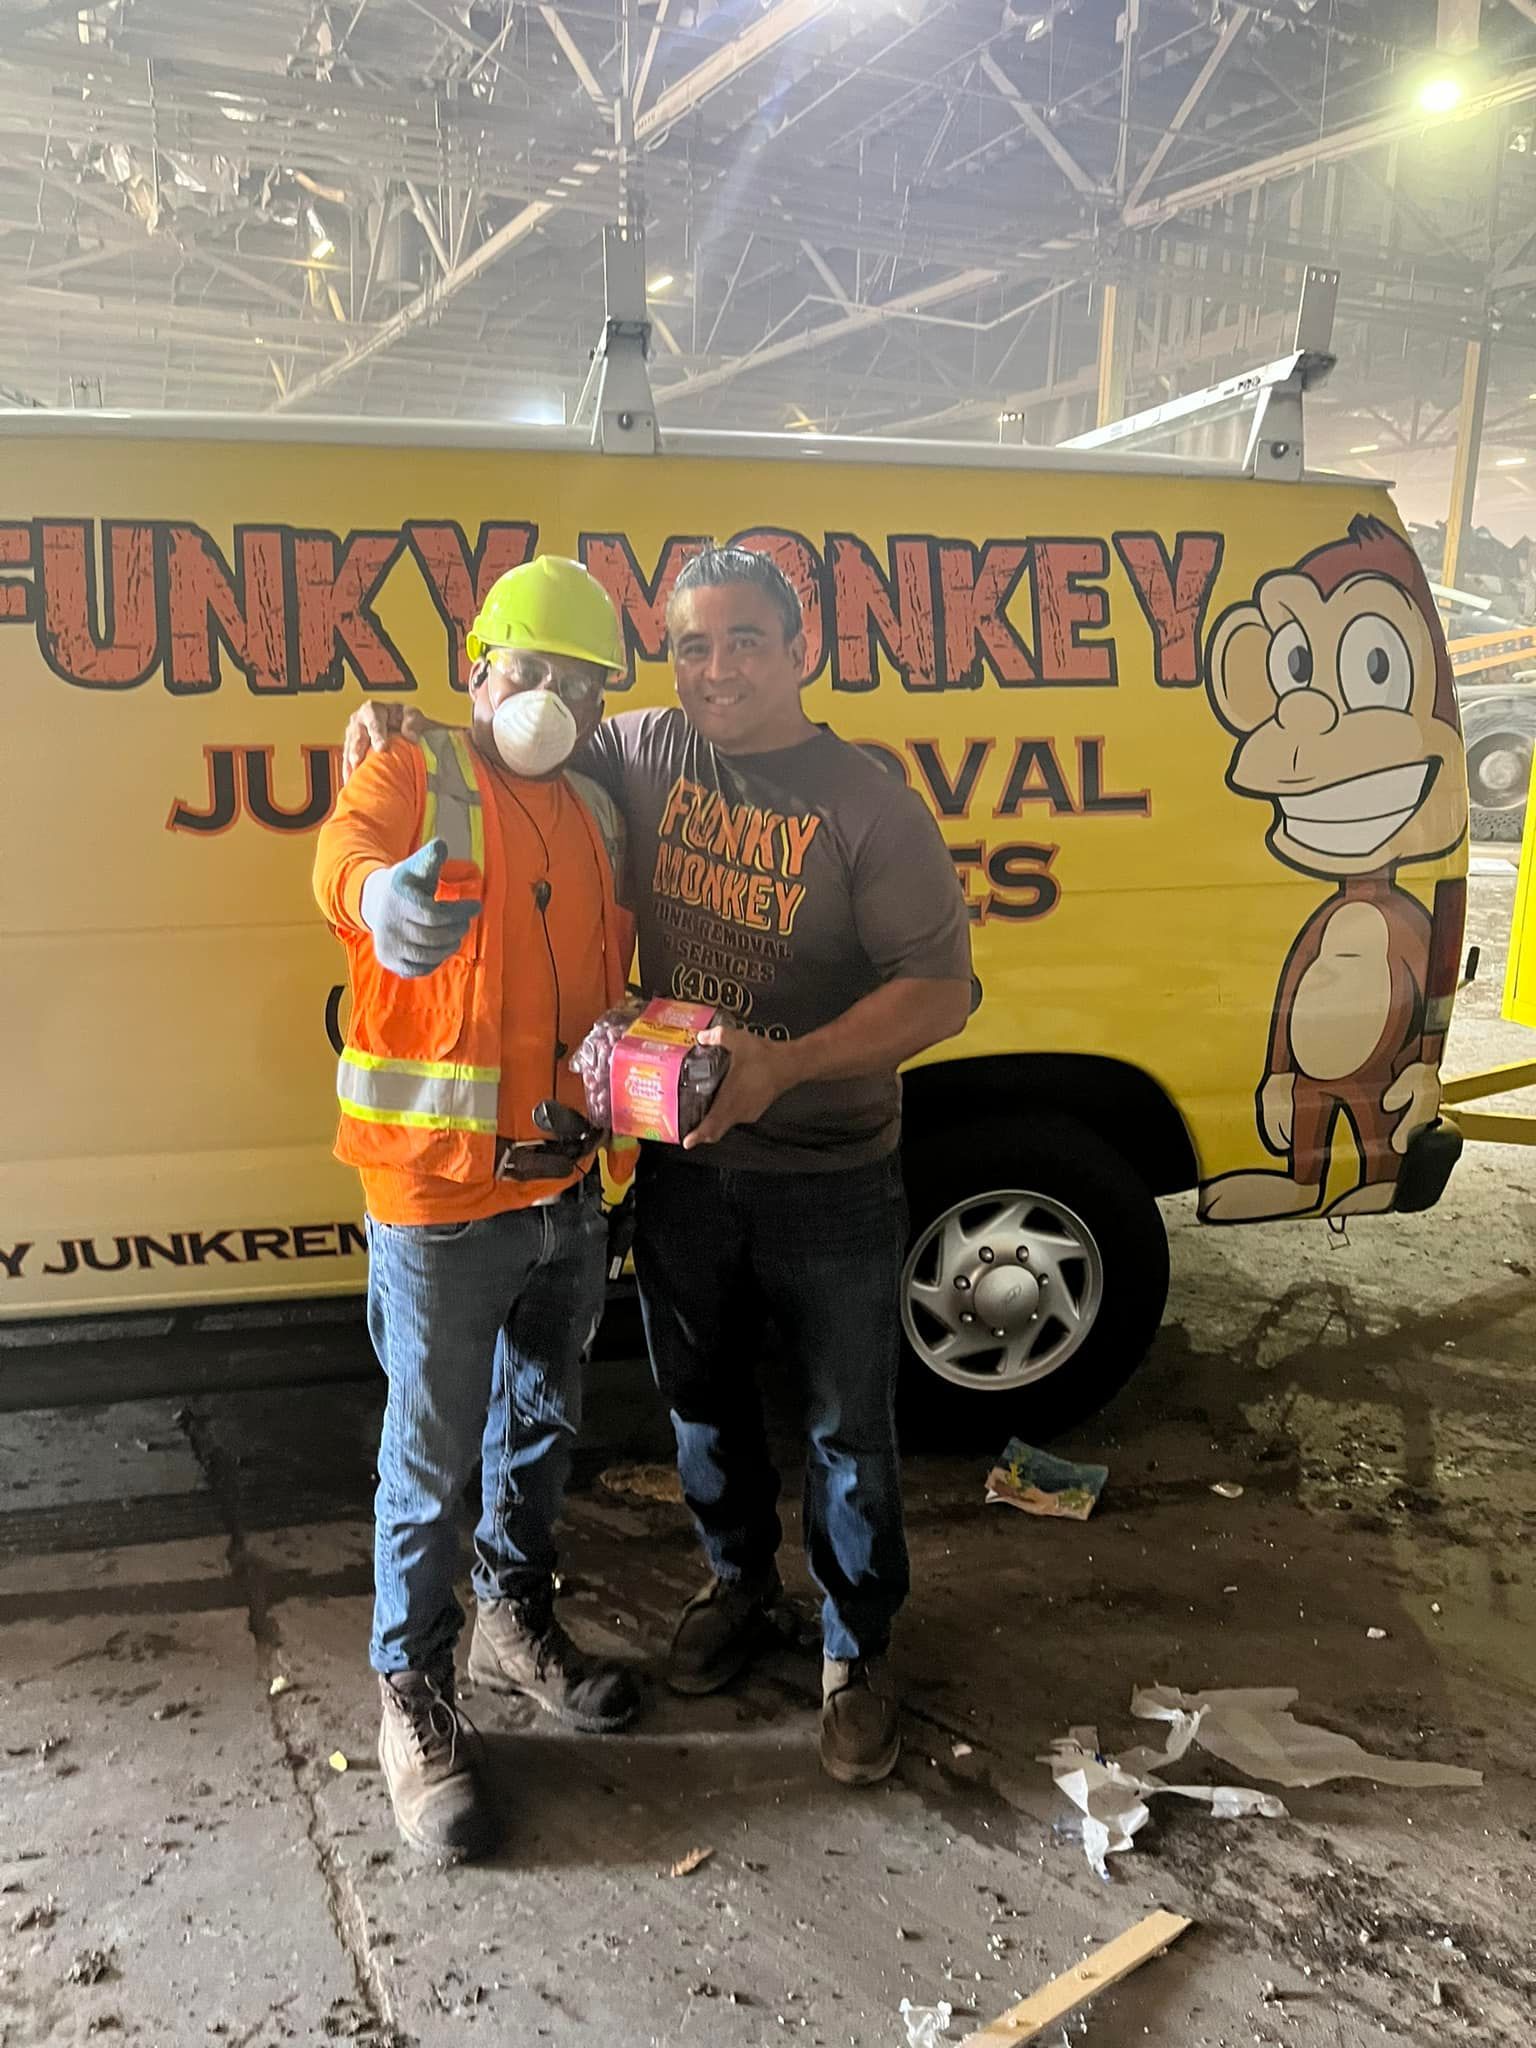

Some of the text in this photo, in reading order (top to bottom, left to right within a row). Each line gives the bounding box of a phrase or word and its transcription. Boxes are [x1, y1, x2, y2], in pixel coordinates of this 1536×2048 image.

[165, 744, 345, 836] JU
[659, 778, 821, 878] FUNKY
[654, 842, 807, 935] MONKEY
[677, 937, 776, 985] SERVICES
[699, 915, 793, 962] REMOVAL
[672, 961, 753, 1018] (408)
